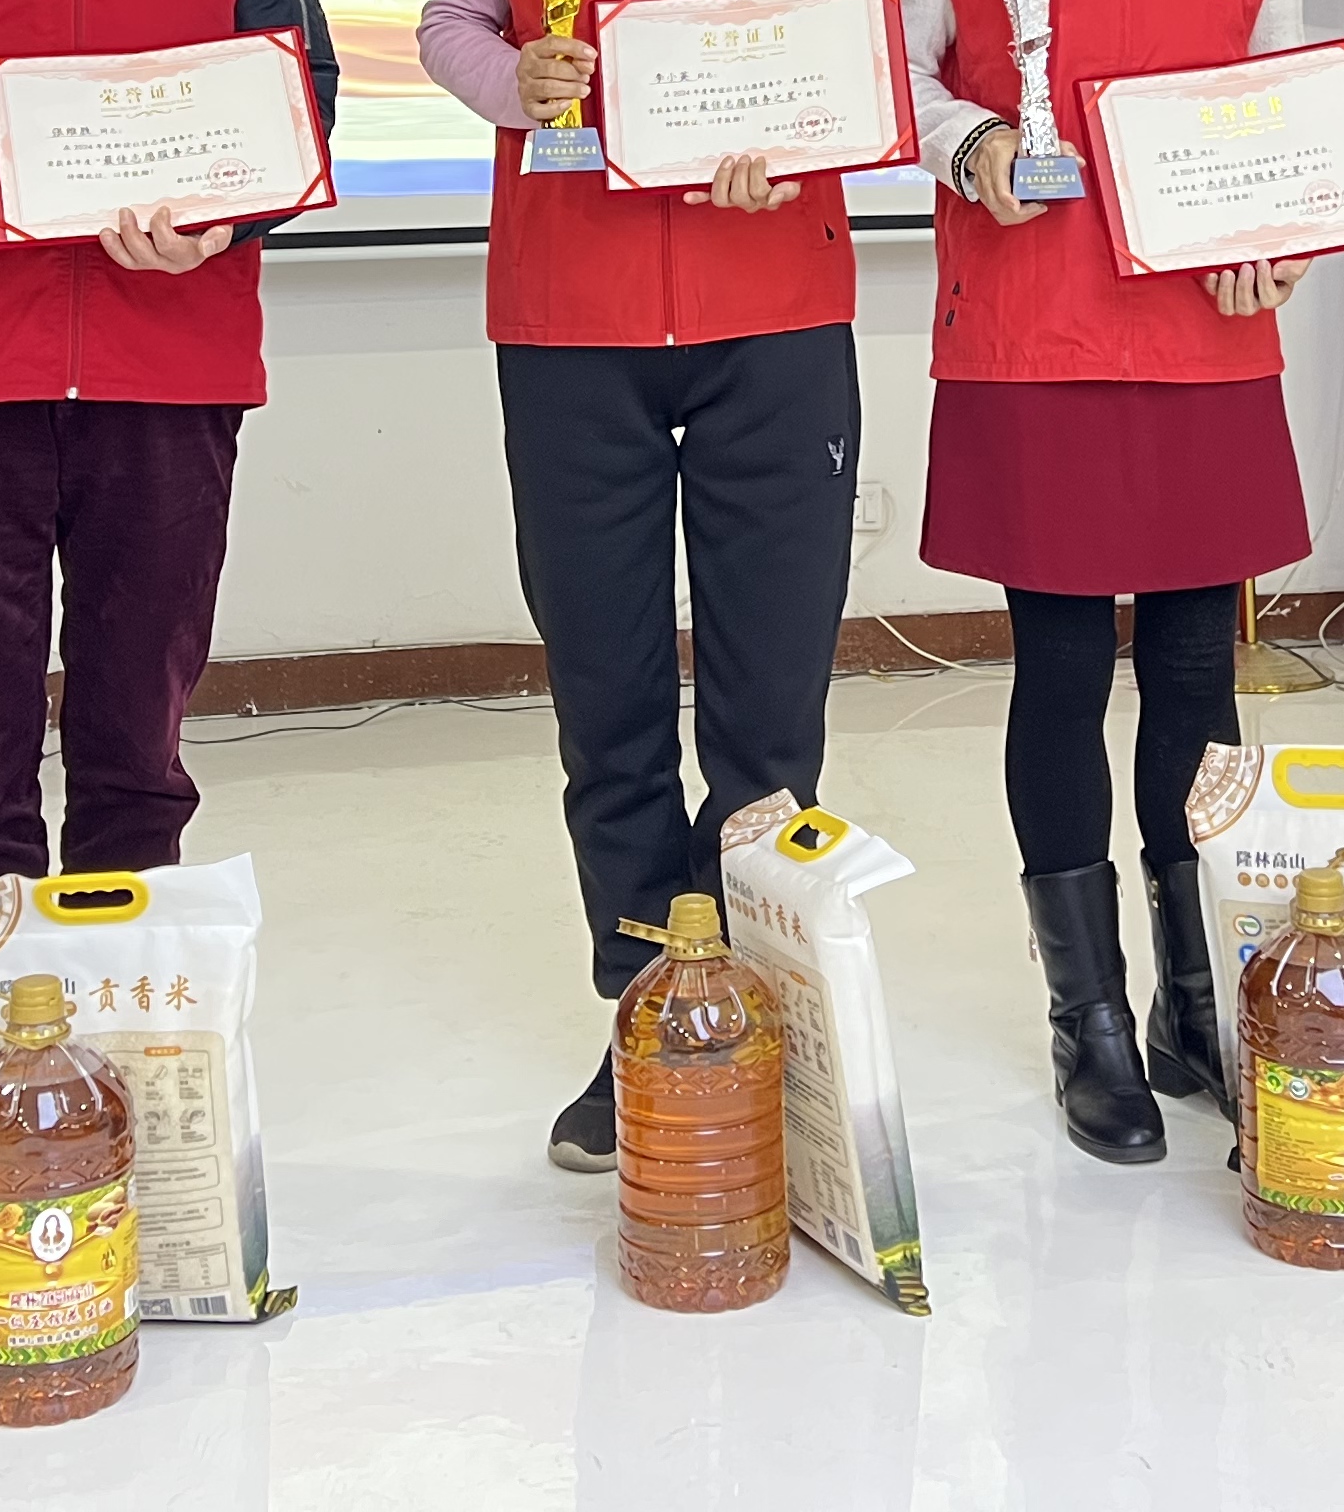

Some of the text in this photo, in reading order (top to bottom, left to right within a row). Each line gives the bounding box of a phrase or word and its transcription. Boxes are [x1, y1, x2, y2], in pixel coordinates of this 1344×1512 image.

[700, 24, 785, 48] 荣誉证书
[99, 81, 192, 105] 荣誉证书
[1236, 850, 1306, 870] 隆林高山
[758, 896, 809, 946] 贡香米
[89, 974, 199, 1013] 贡香米
